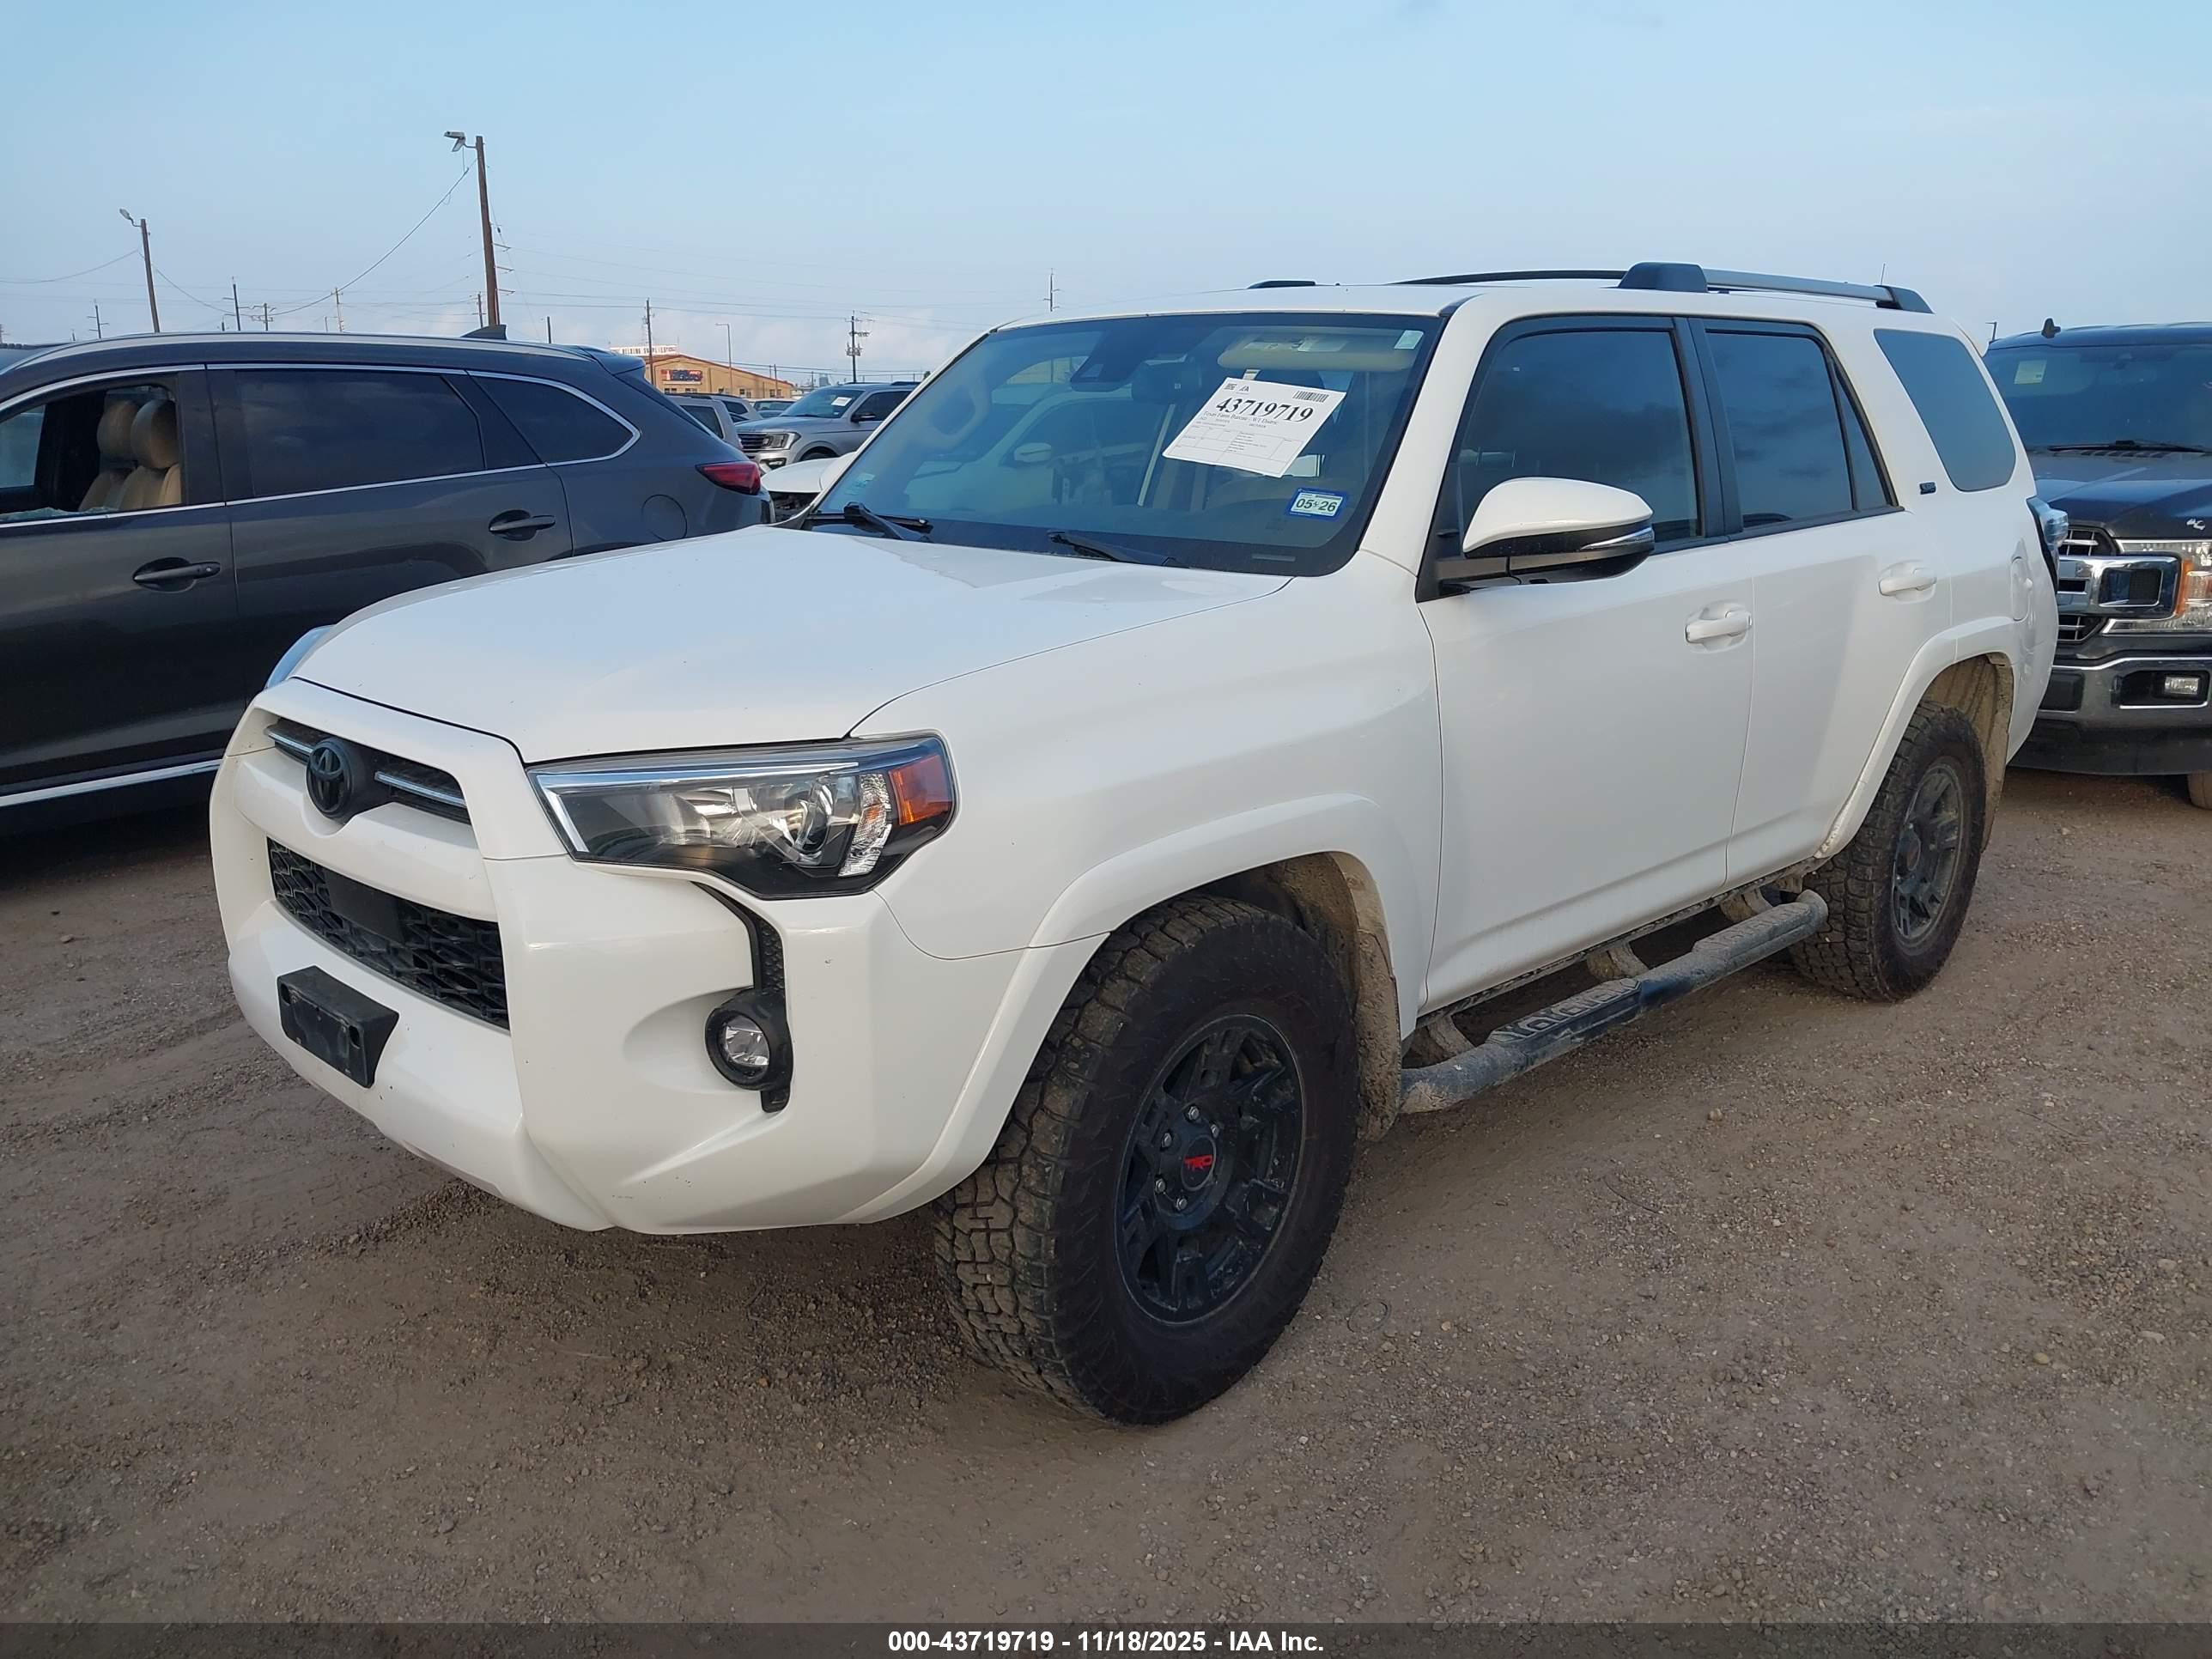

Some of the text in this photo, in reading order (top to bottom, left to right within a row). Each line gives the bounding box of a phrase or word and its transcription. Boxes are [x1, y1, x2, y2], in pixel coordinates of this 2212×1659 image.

[1216, 397, 1314, 422] 43719719
[1296, 498, 1338, 512] 05 26
